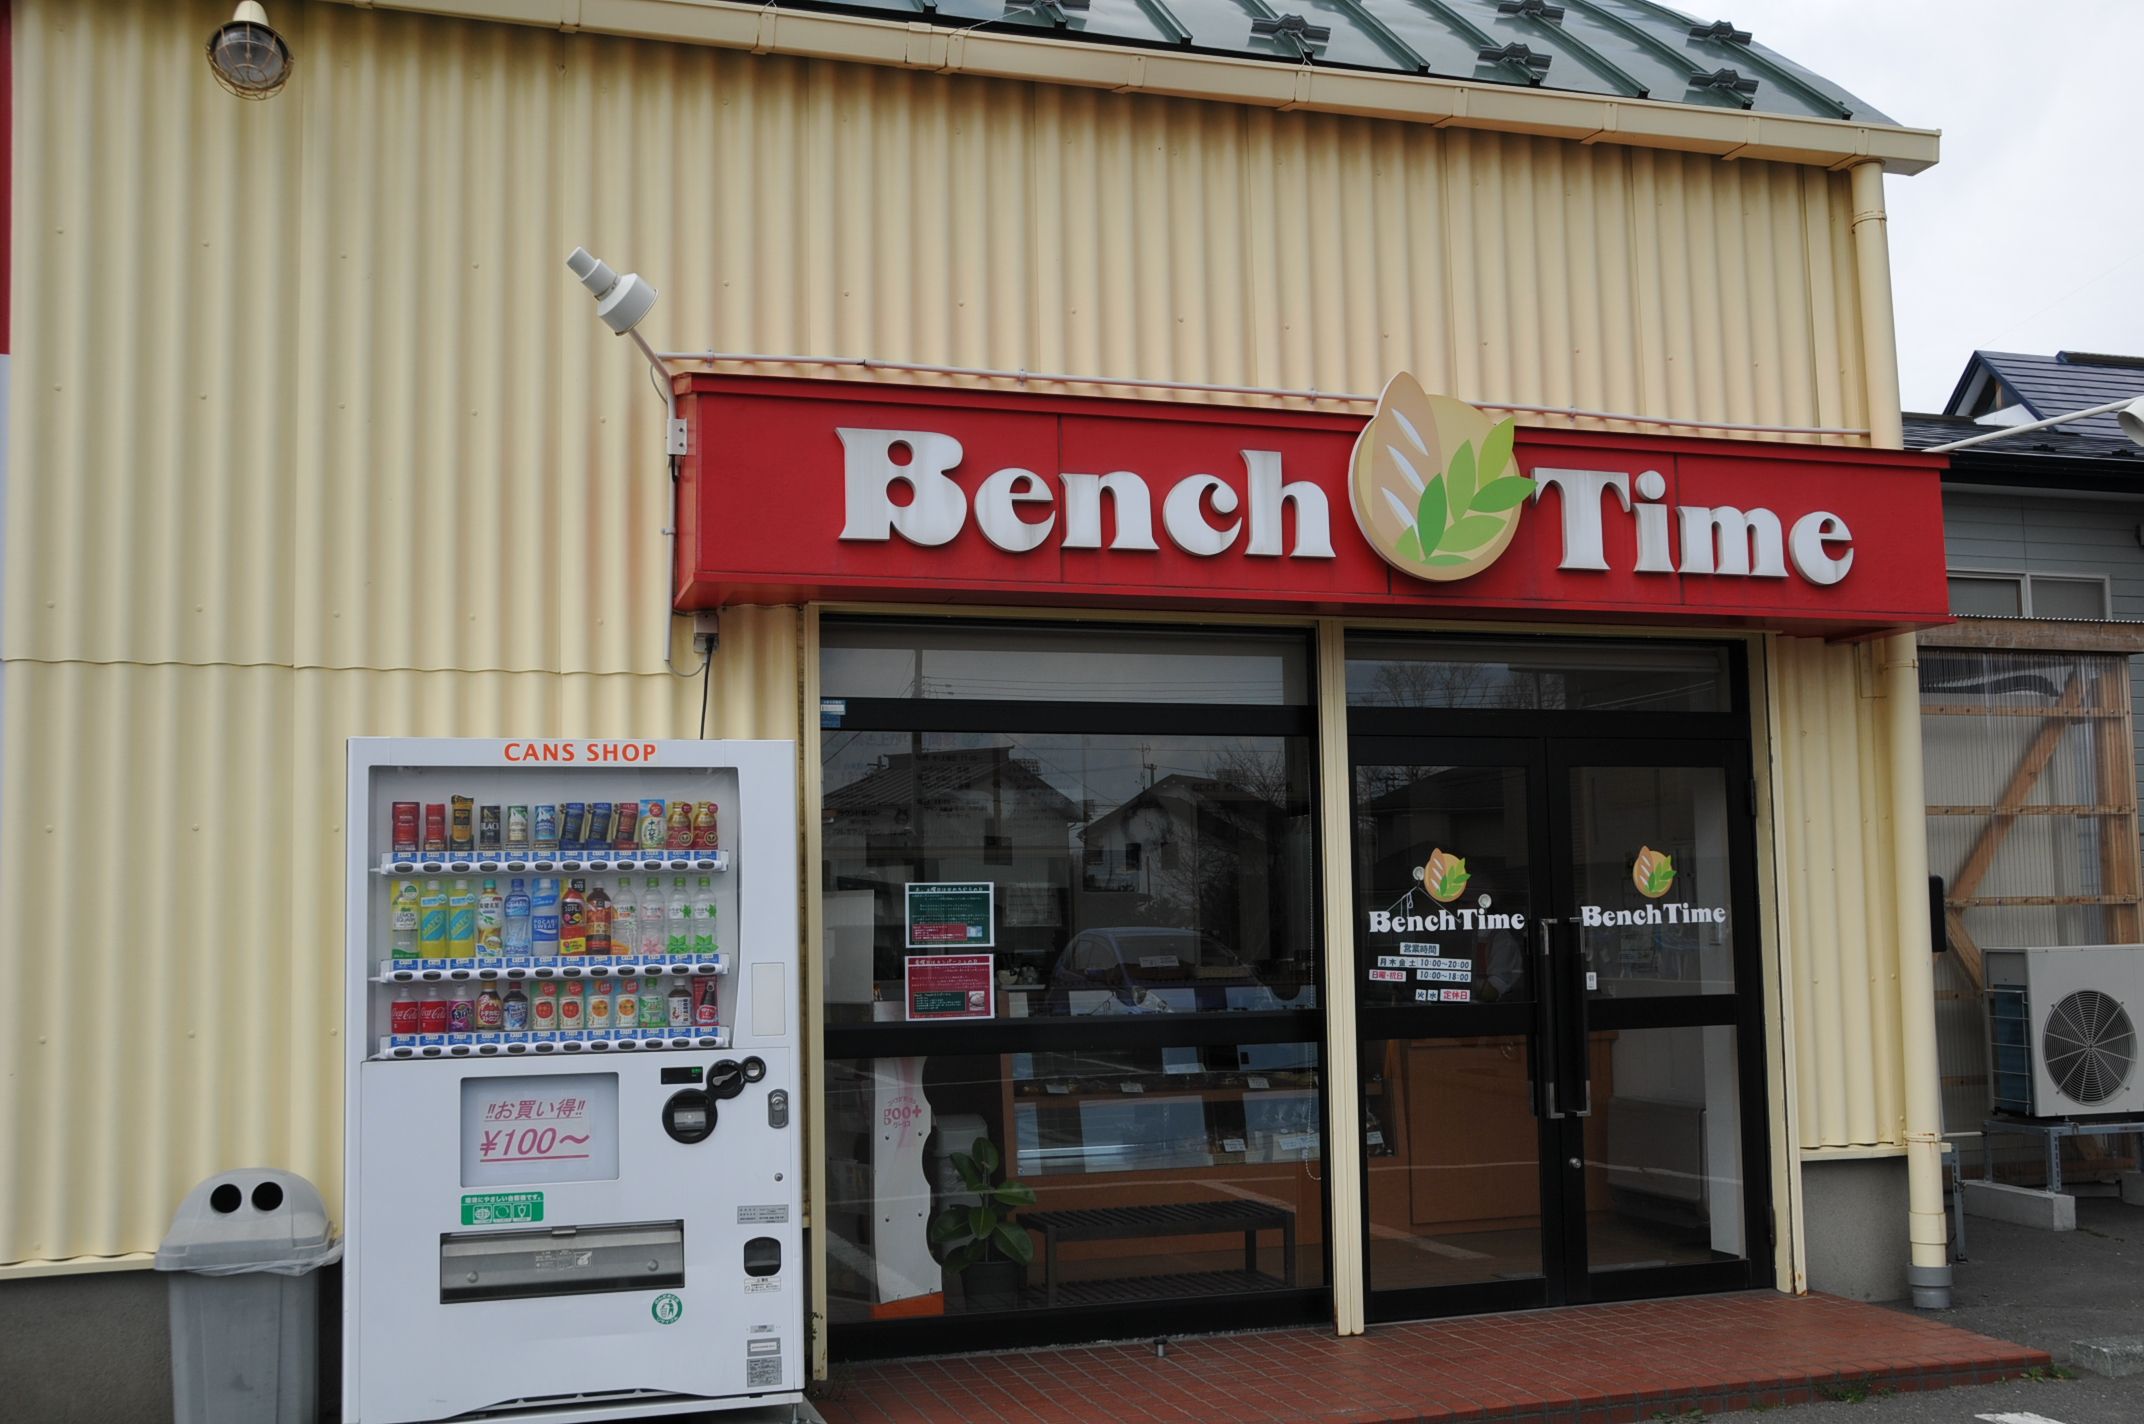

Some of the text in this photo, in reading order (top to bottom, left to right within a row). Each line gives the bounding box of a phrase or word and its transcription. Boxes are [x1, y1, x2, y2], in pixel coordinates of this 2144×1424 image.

[835, 427, 1854, 585] Bench Time
[504, 743, 656, 762] CANS SHOP
[1403, 944, 1437, 954] 営業時間
